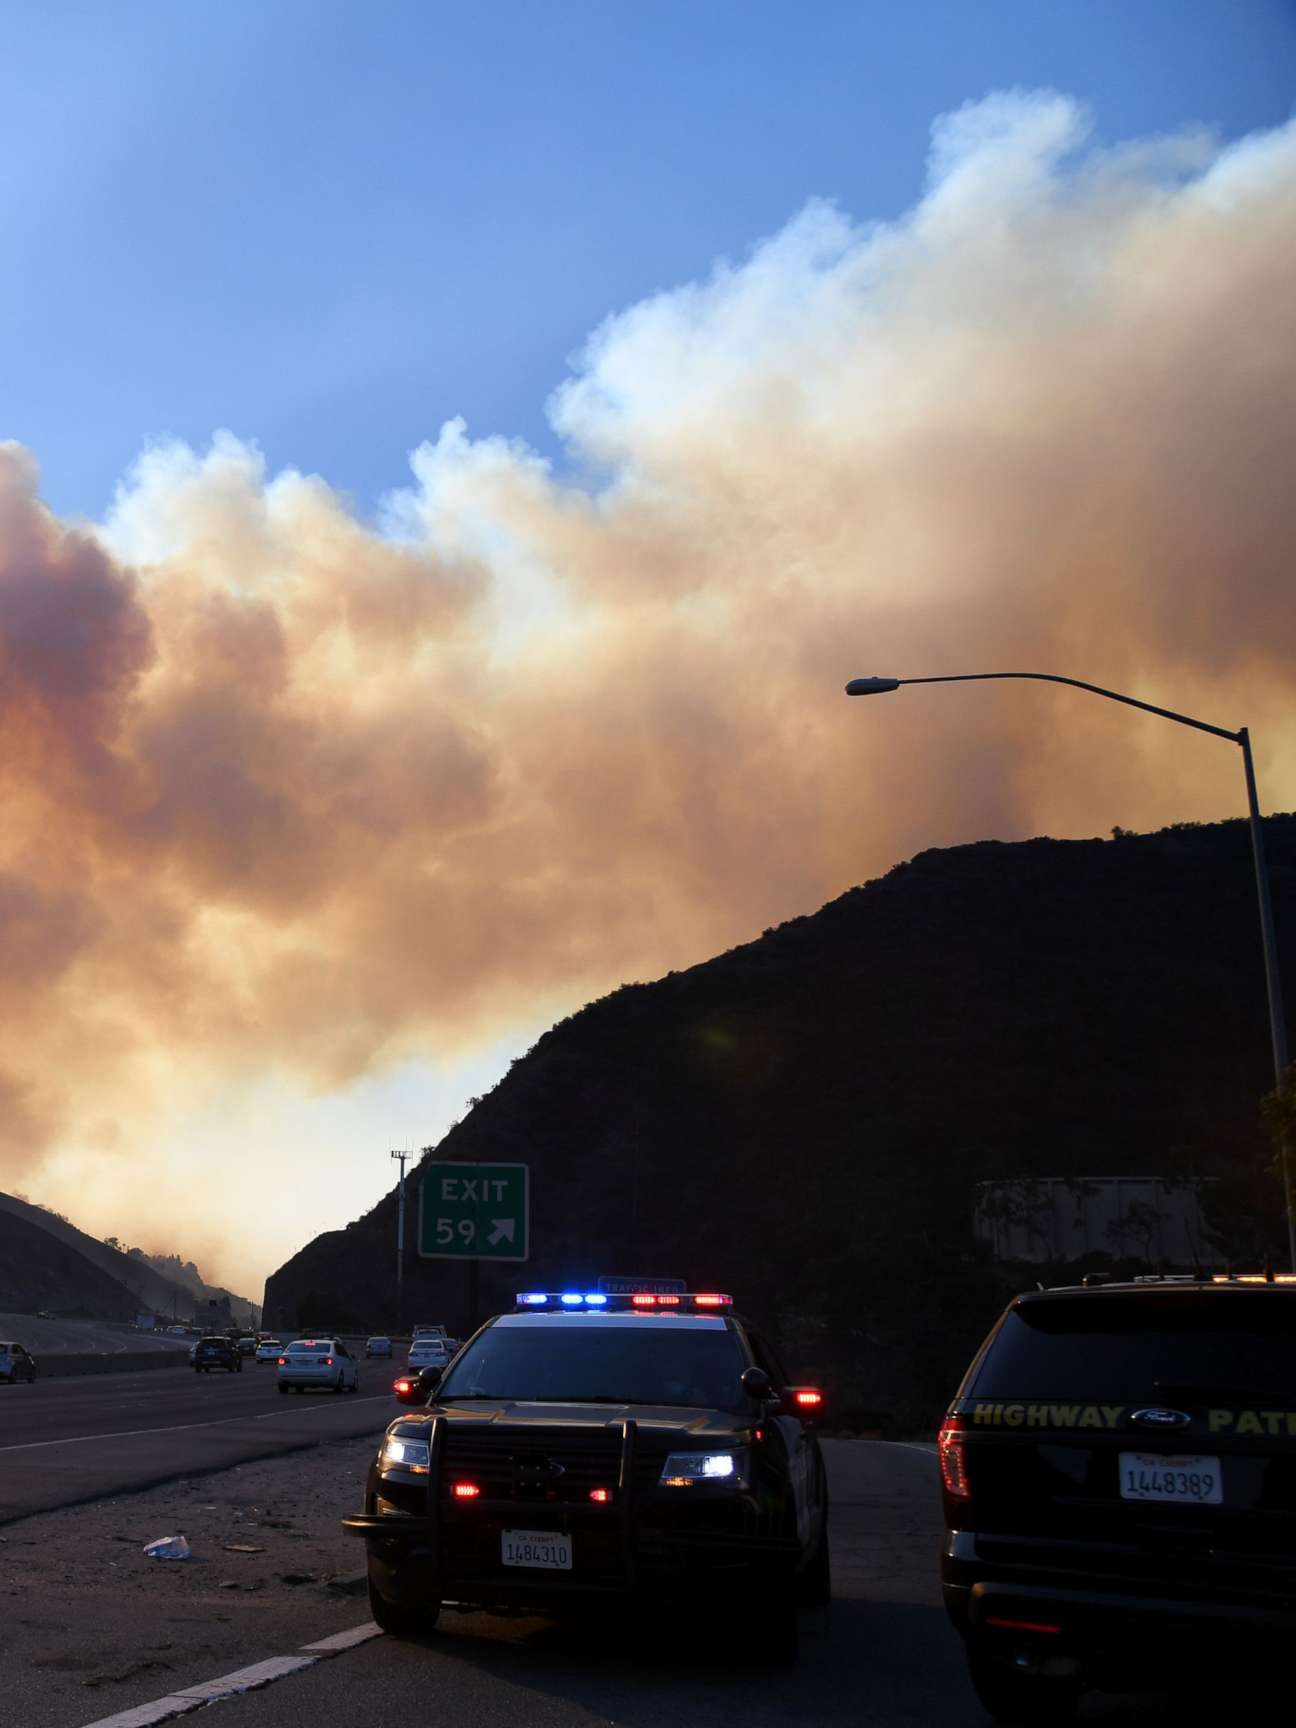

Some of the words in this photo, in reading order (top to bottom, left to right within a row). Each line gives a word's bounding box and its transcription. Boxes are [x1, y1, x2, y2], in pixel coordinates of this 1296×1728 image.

[440, 1178, 509, 1202] EXIT
[436, 1217, 475, 1246] 59
[973, 1403, 1124, 1430] HIGHWAY
[1127, 1470, 1214, 1497] 1448389
[506, 1543, 567, 1564] 1484310
